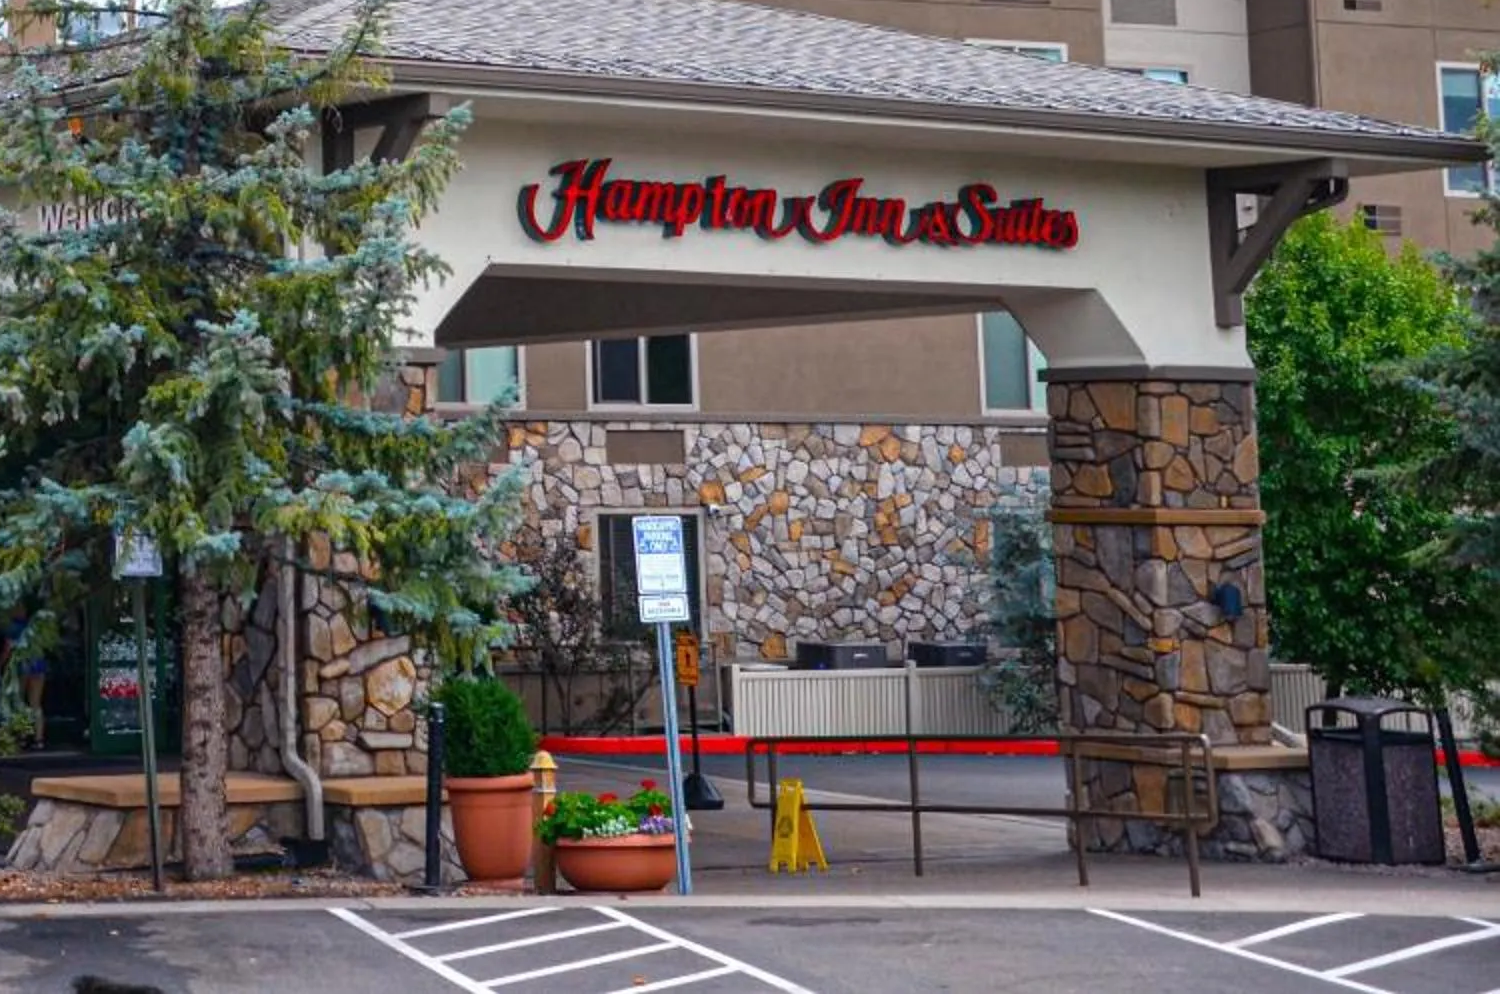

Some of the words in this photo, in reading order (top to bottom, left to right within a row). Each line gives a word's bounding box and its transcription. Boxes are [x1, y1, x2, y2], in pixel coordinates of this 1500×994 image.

[517, 158, 799, 243] Hampton
[796, 177, 920, 246] Inn
[952, 183, 1079, 250] Suites
